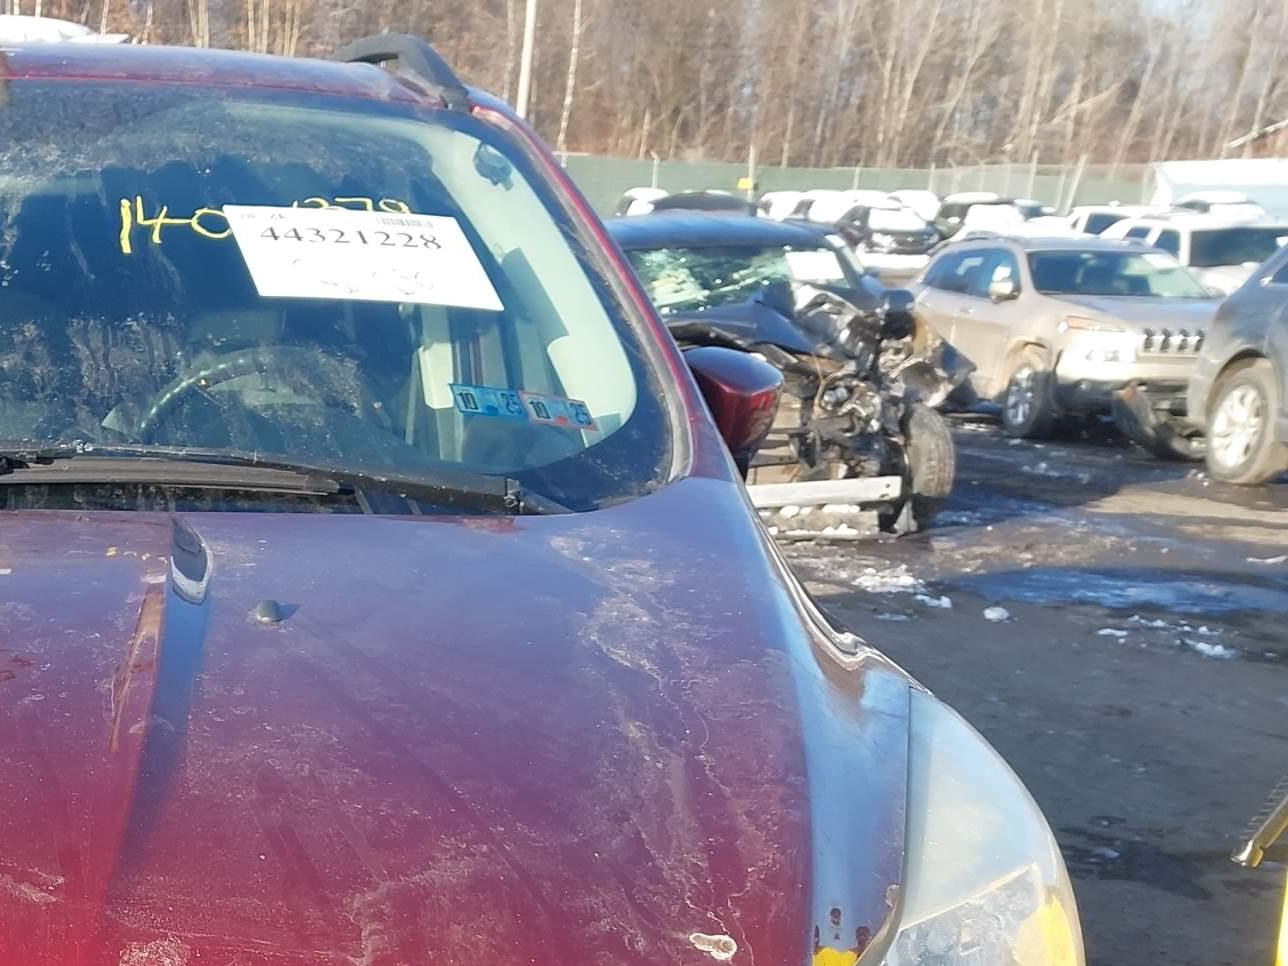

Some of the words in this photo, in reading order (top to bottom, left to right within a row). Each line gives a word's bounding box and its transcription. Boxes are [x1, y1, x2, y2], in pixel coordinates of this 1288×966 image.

[260, 225, 443, 250] 44321228
[457, 391, 479, 411] 10
[528, 400, 551, 420] 10
